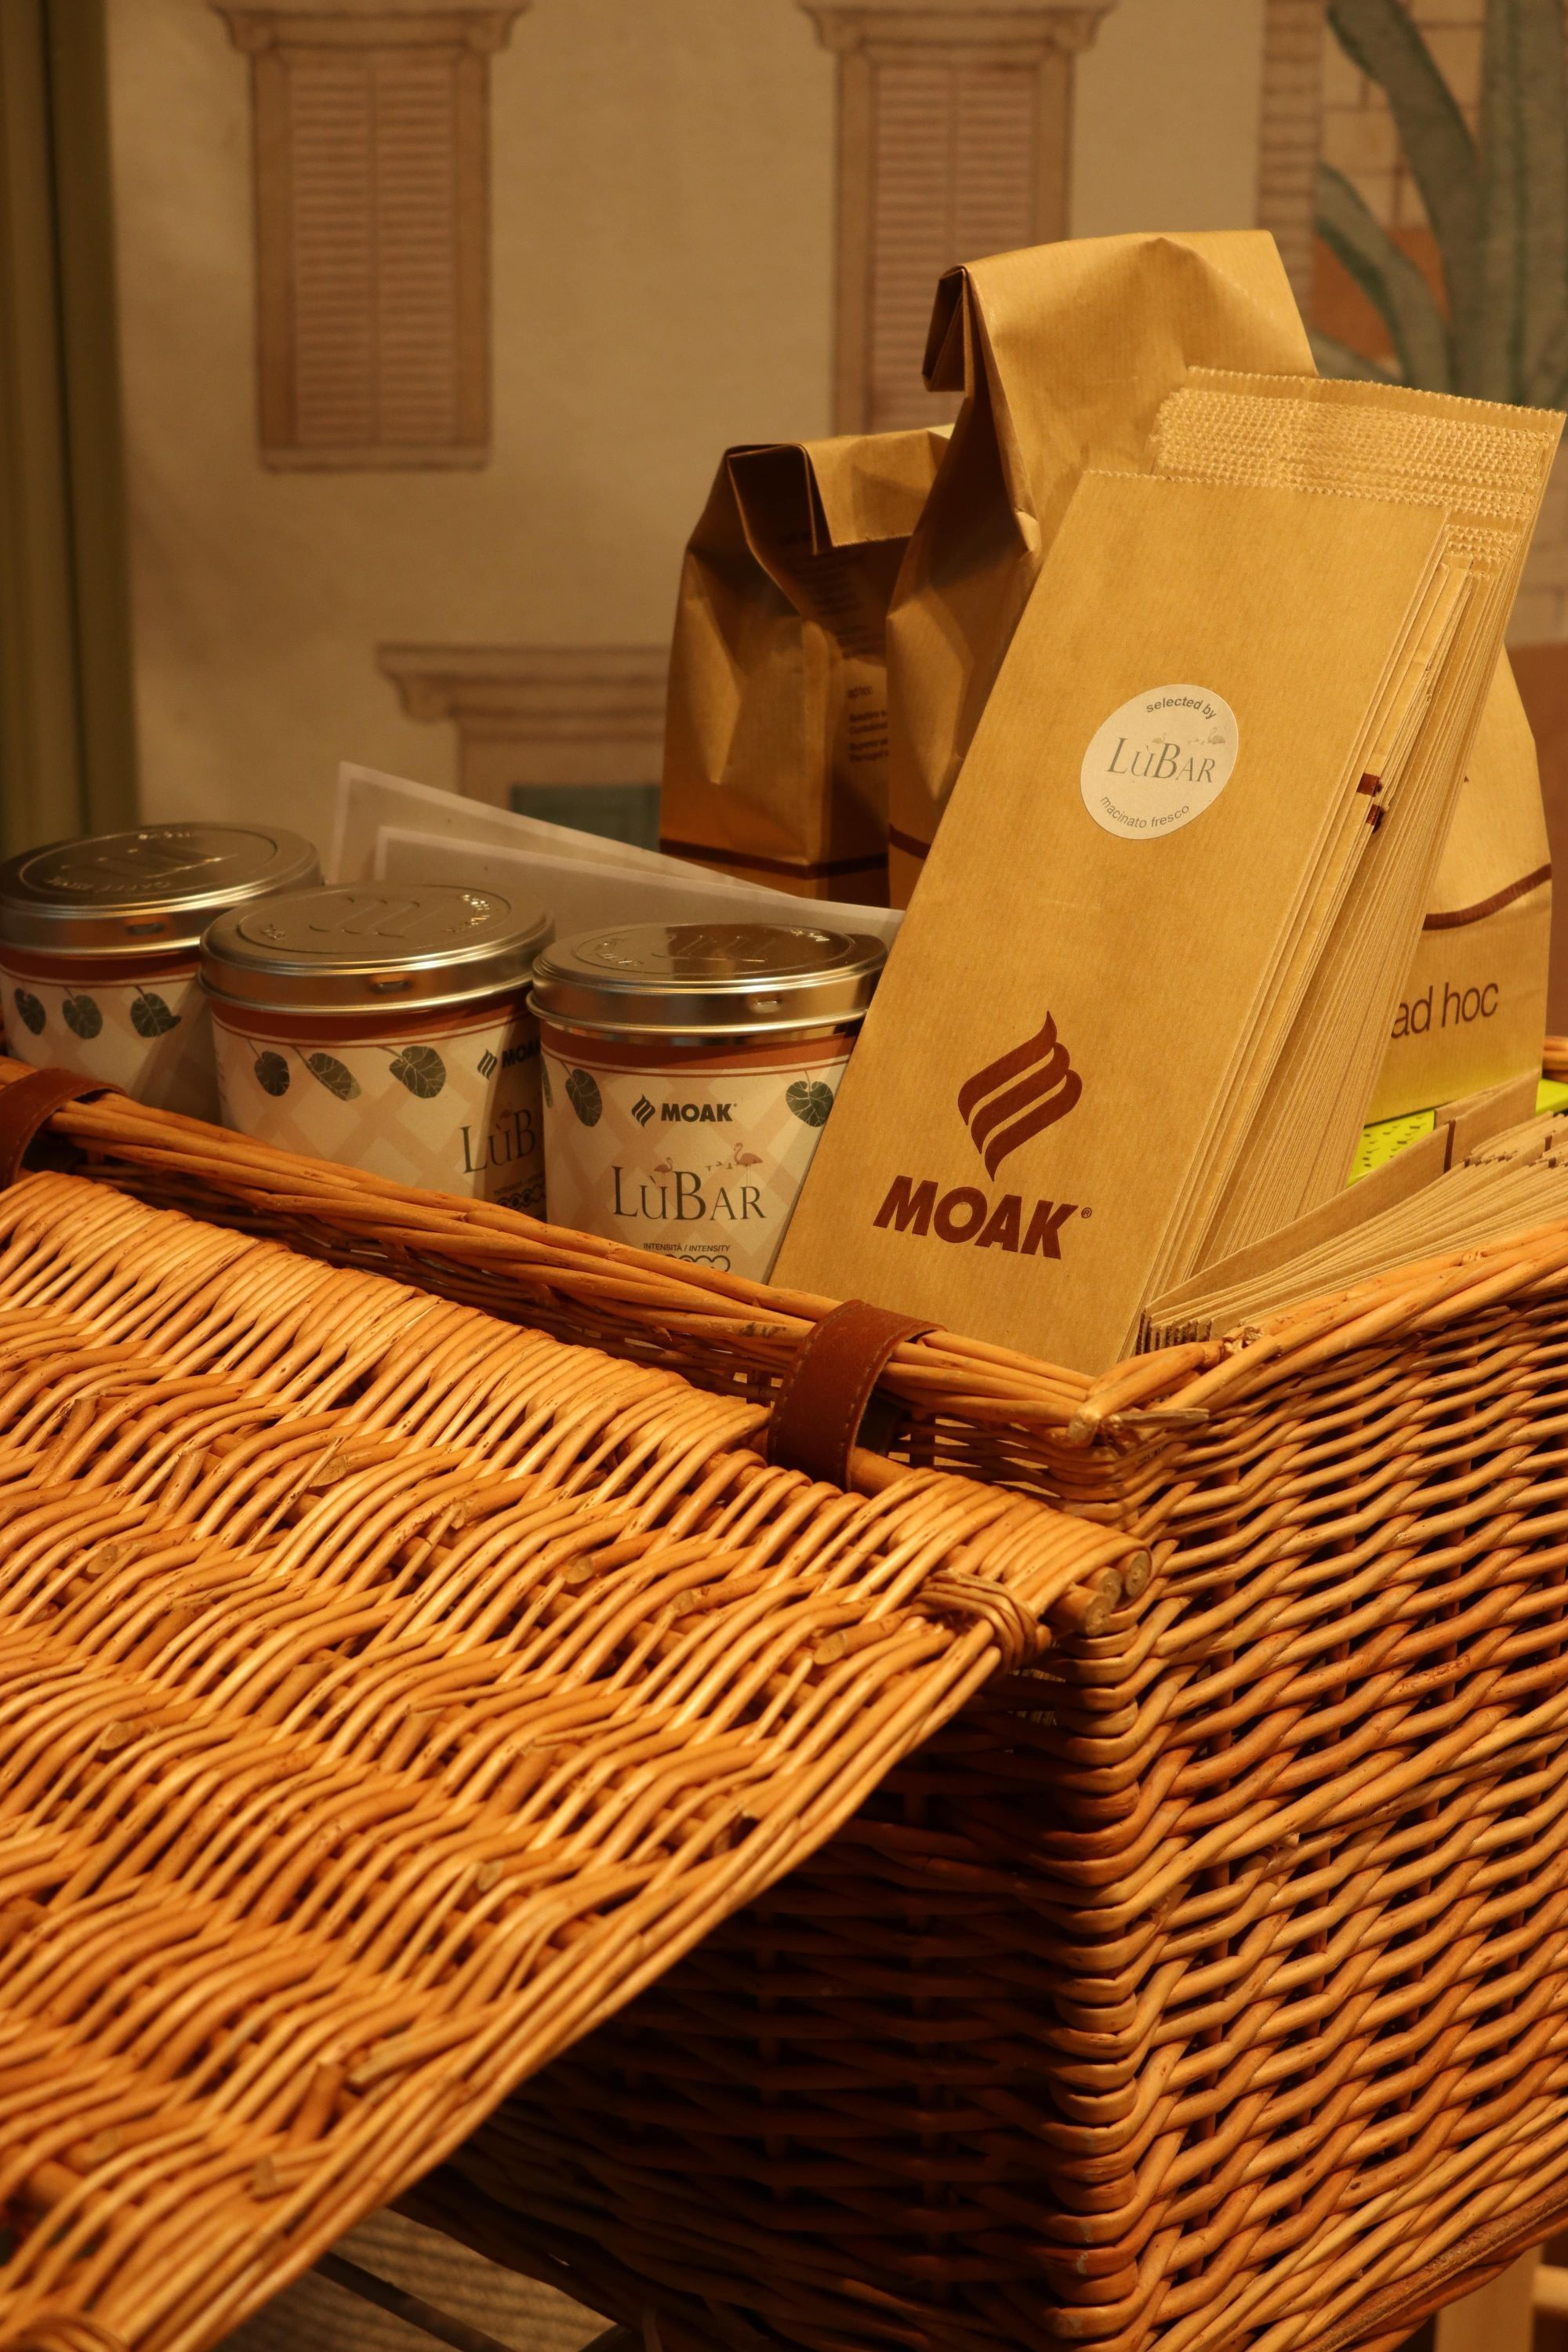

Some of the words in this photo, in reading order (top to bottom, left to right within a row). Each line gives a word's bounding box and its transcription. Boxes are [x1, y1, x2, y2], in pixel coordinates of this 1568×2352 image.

[1146, 696, 1203, 713] selected
[1202, 703, 1217, 720] by
[1100, 797, 1147, 829] macinato
[1151, 804, 1190, 828] fresco
[1391, 985, 1433, 1039] ad
[1441, 982, 1499, 1028] hoc
[459, 1109, 535, 1174] LùB
[643, 1242, 682, 1251] INTENSITÀ
